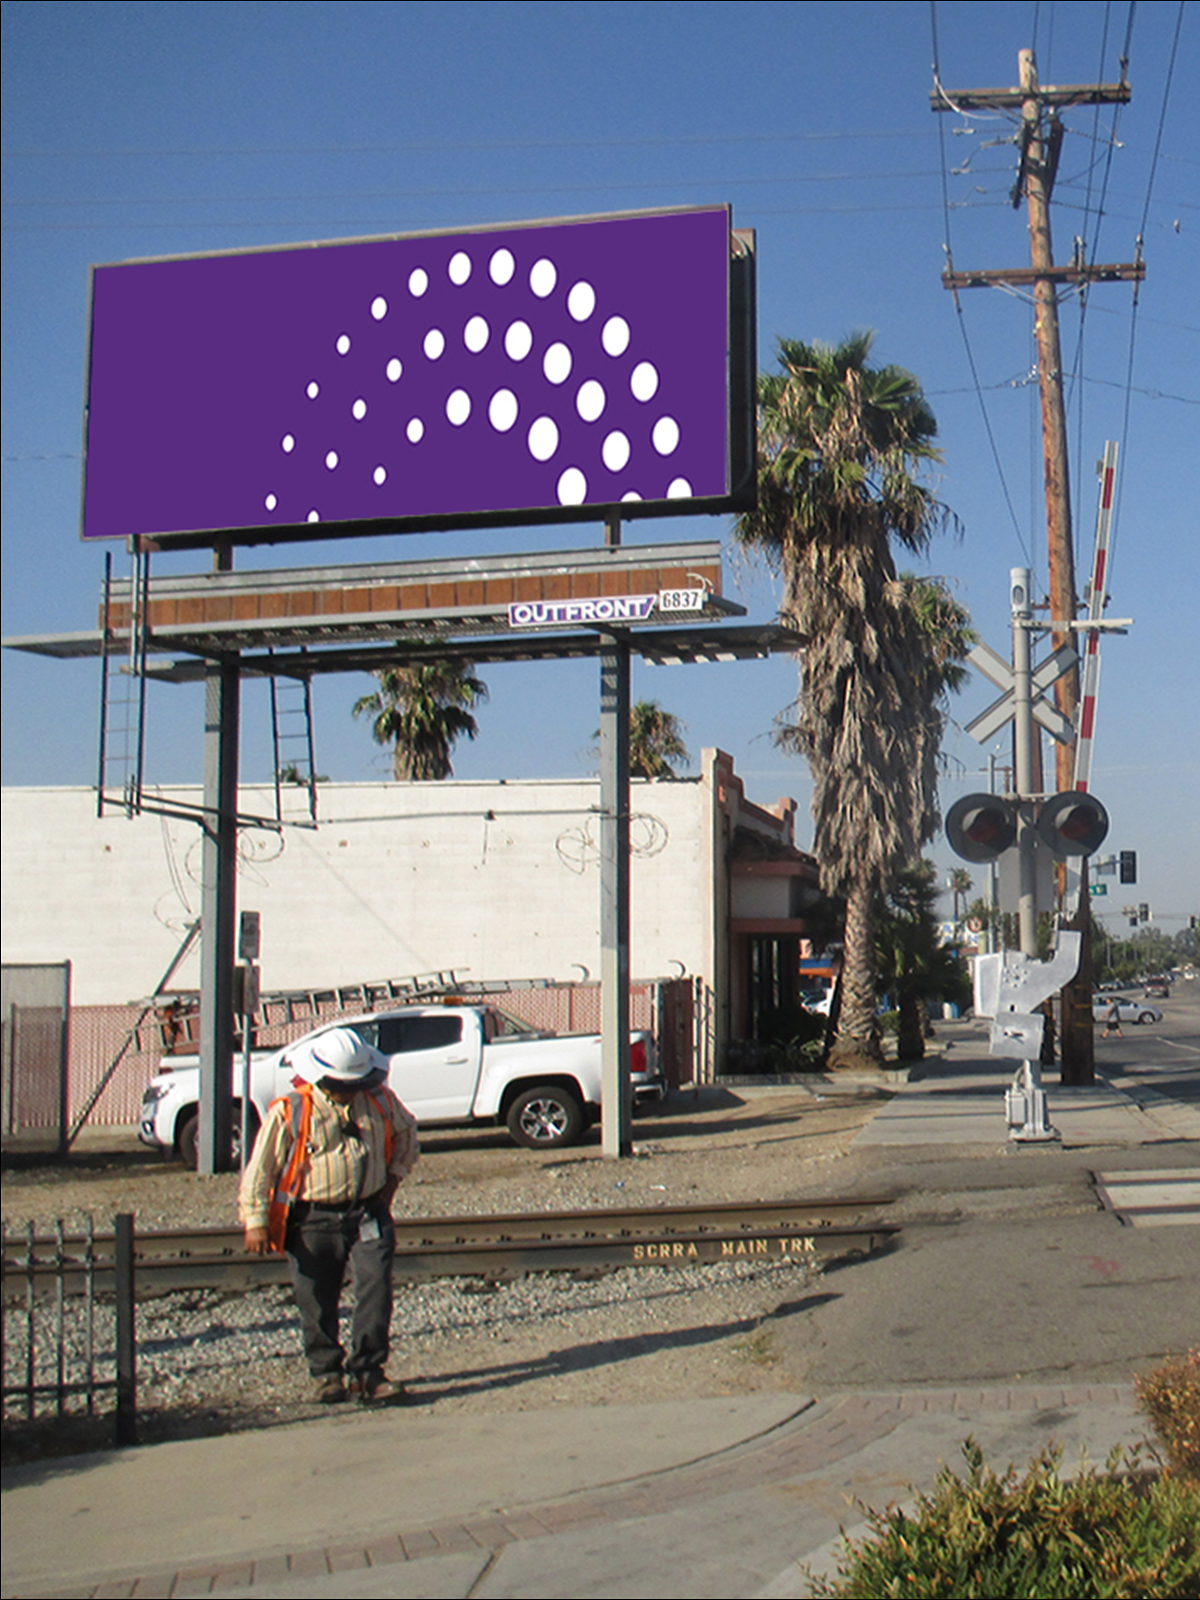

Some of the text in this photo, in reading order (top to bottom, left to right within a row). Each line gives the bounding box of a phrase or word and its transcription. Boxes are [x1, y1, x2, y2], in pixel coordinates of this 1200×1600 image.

[514, 599, 648, 623] OUTFRONT
[663, 591, 699, 608] 6837
[633, 1237, 817, 1260] SCRRA MAIN TRK
